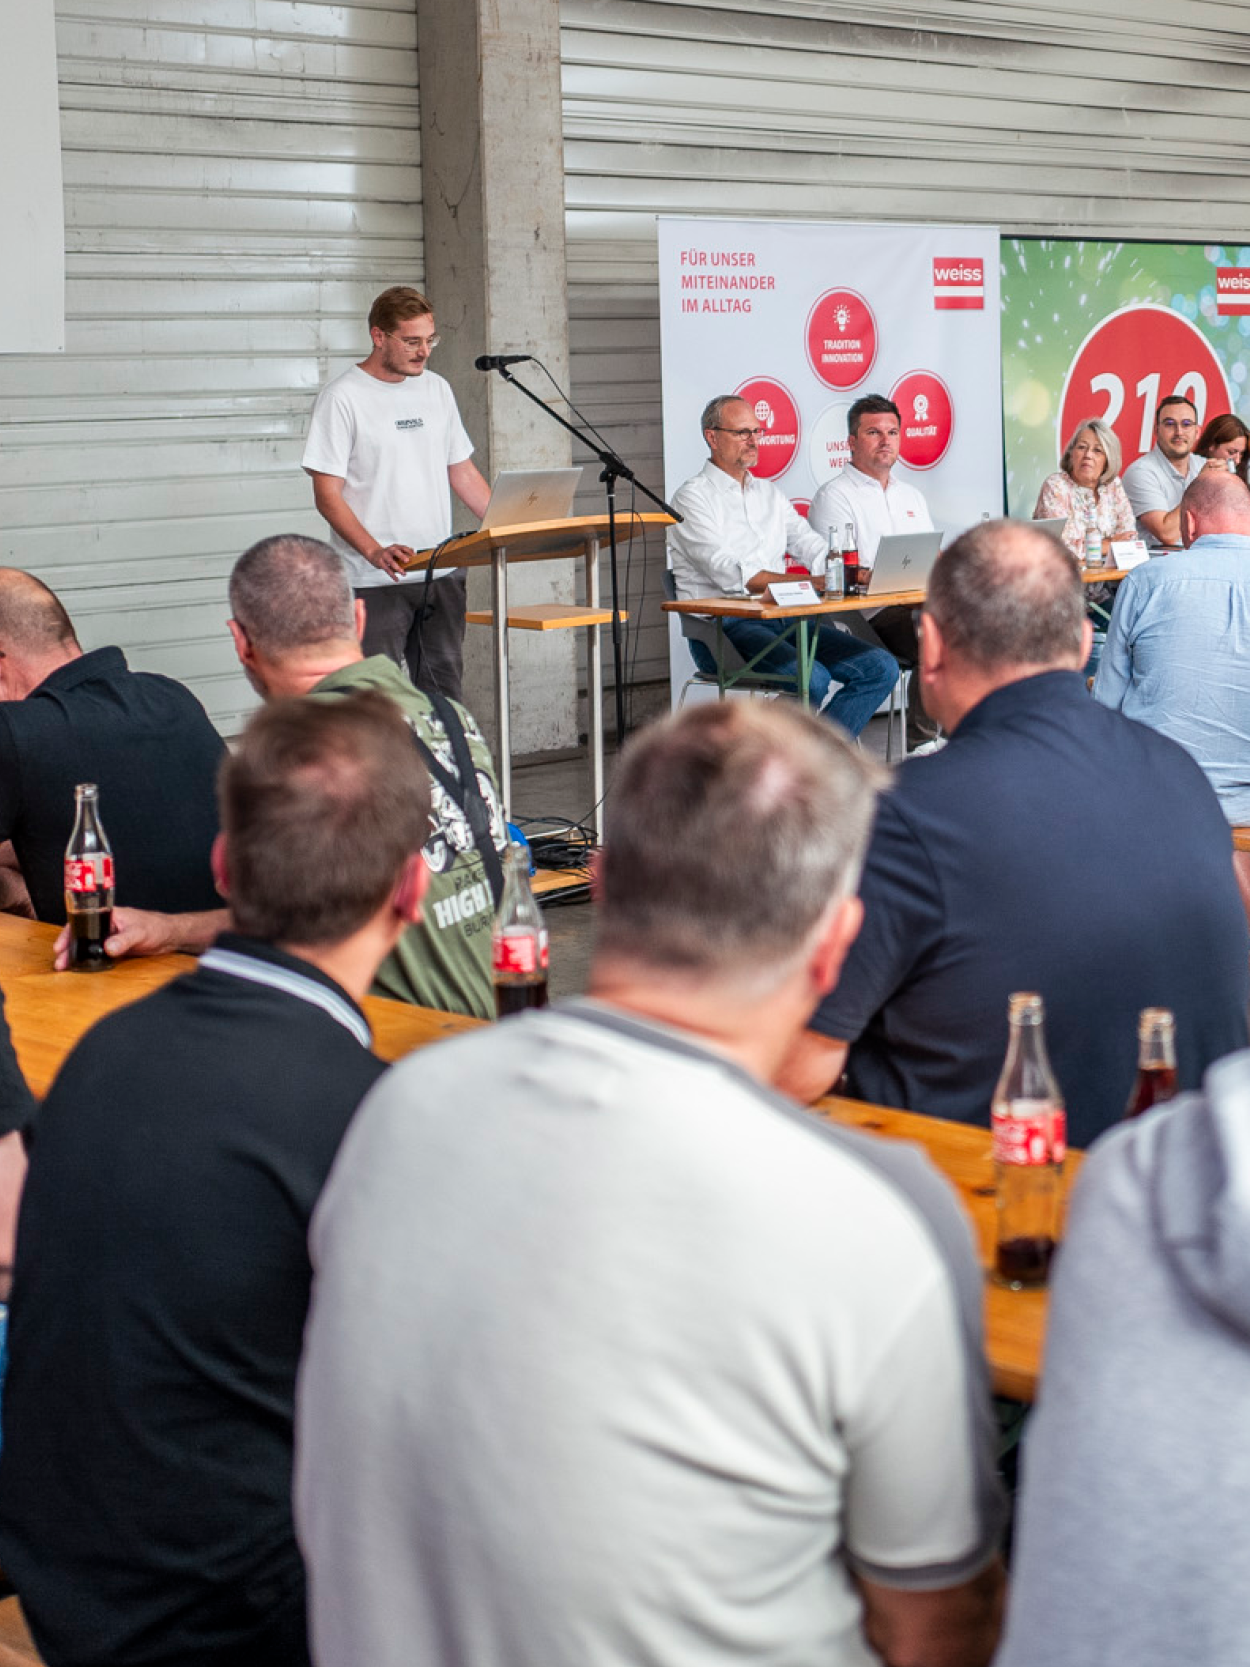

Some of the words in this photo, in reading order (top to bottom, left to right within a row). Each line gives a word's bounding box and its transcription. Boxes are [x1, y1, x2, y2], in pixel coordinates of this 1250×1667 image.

[680, 249, 708, 267] FÜR
[710, 252, 756, 267] UNSER
[933, 263, 983, 281] weiss
[681, 274, 776, 290] MITEINANDER
[681, 298, 699, 313] IM
[702, 298, 752, 313] ALLTAG
[823, 339, 861, 350] TRADITION
[821, 352, 864, 363] INNOVATION
[905, 425, 938, 438] QUALITÄT
[758, 434, 796, 447] WORTUNG
